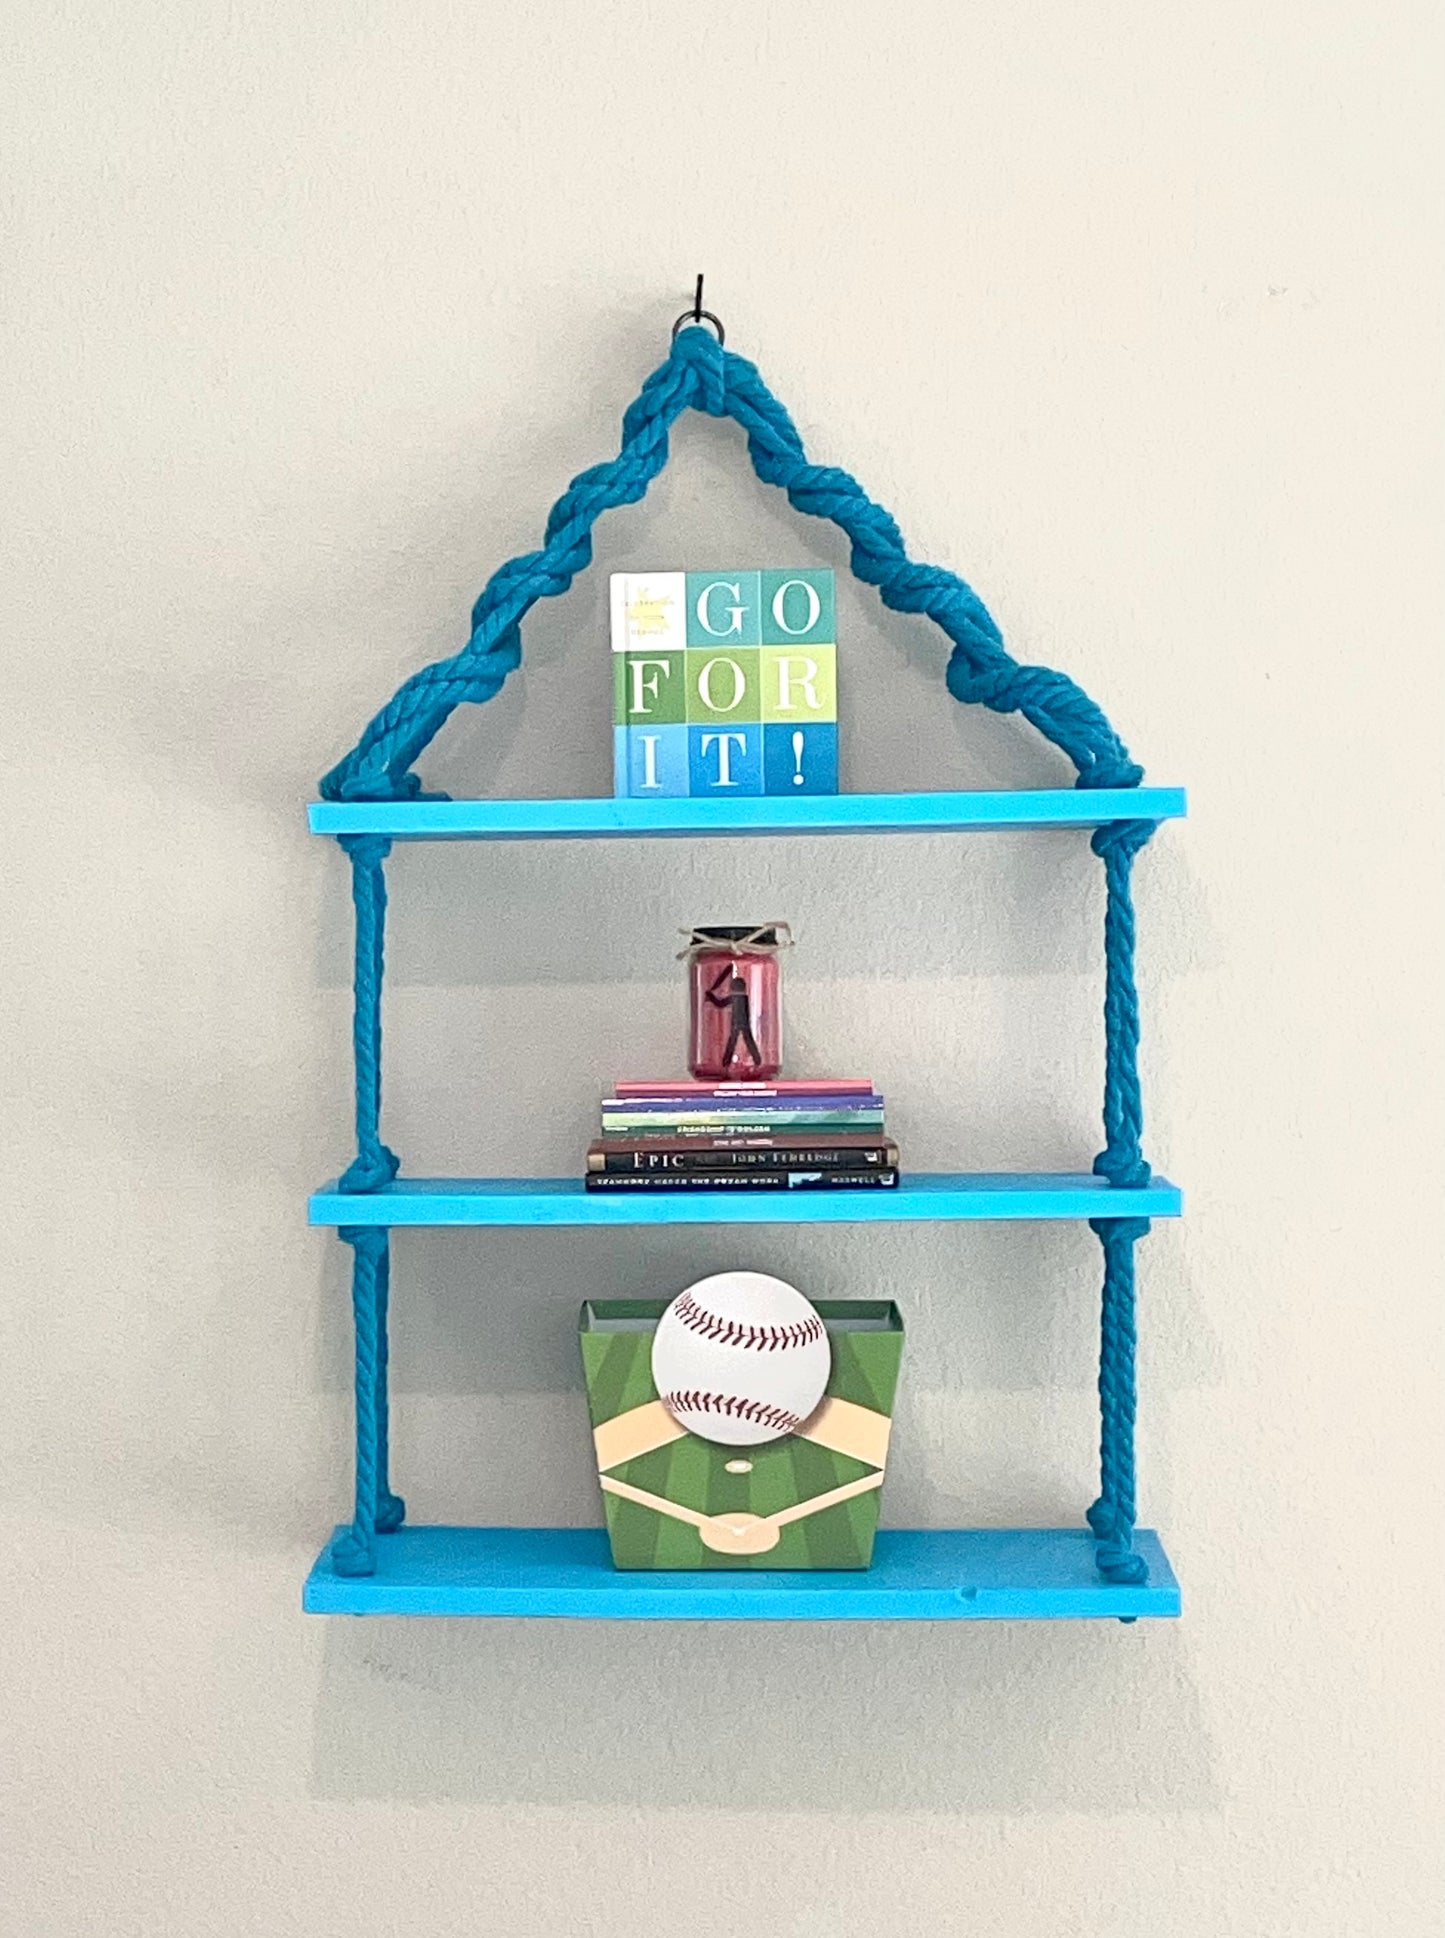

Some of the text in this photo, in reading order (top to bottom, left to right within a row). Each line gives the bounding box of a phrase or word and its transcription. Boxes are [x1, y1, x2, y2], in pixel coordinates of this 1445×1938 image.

[697, 579, 821, 636] GO
[628, 656, 824, 713] FOR
[637, 731, 804, 788] IT!
[634, 1152, 685, 1168] EPIC
